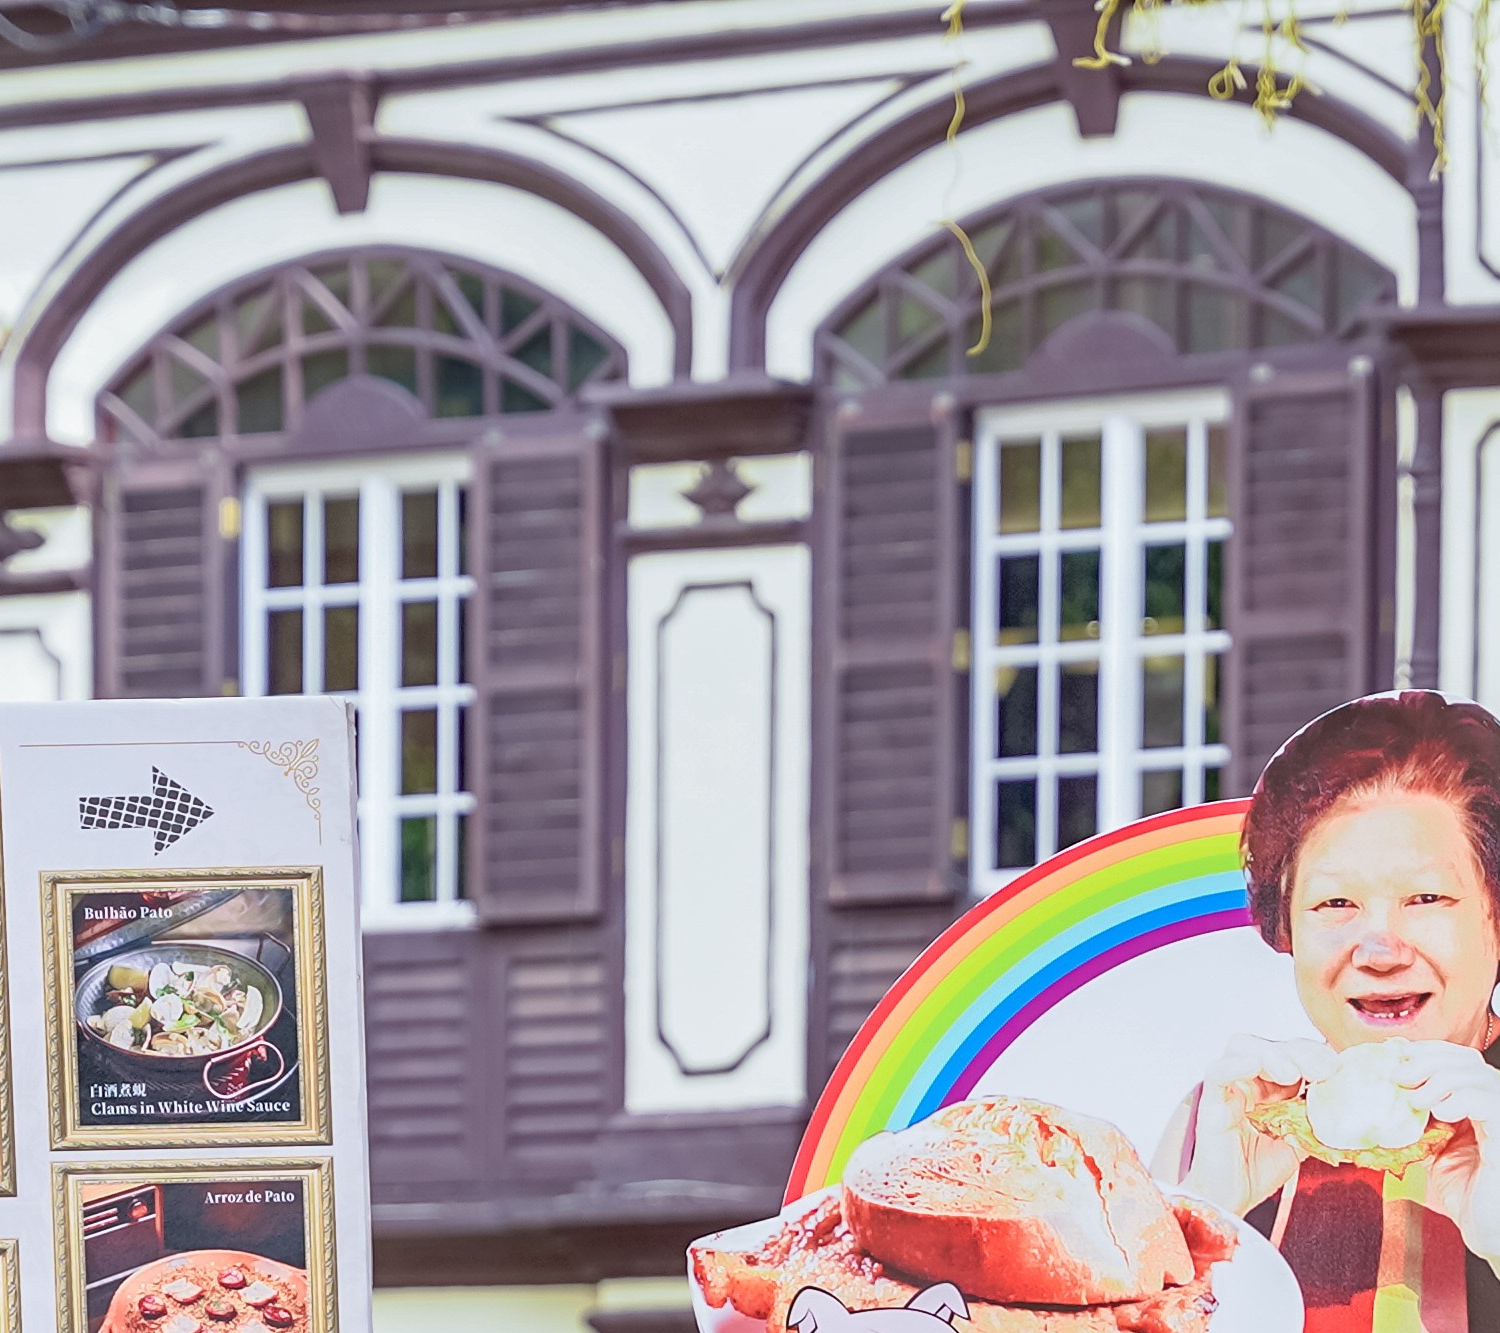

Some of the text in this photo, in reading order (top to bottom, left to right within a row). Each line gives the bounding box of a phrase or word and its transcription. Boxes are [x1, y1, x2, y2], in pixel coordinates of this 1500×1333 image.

[83, 905, 173, 920] Bulhão Pato
[90, 1098, 291, 1115] Clams in White Wine Sauce
[204, 1189, 295, 1204] Arroz de Pato
